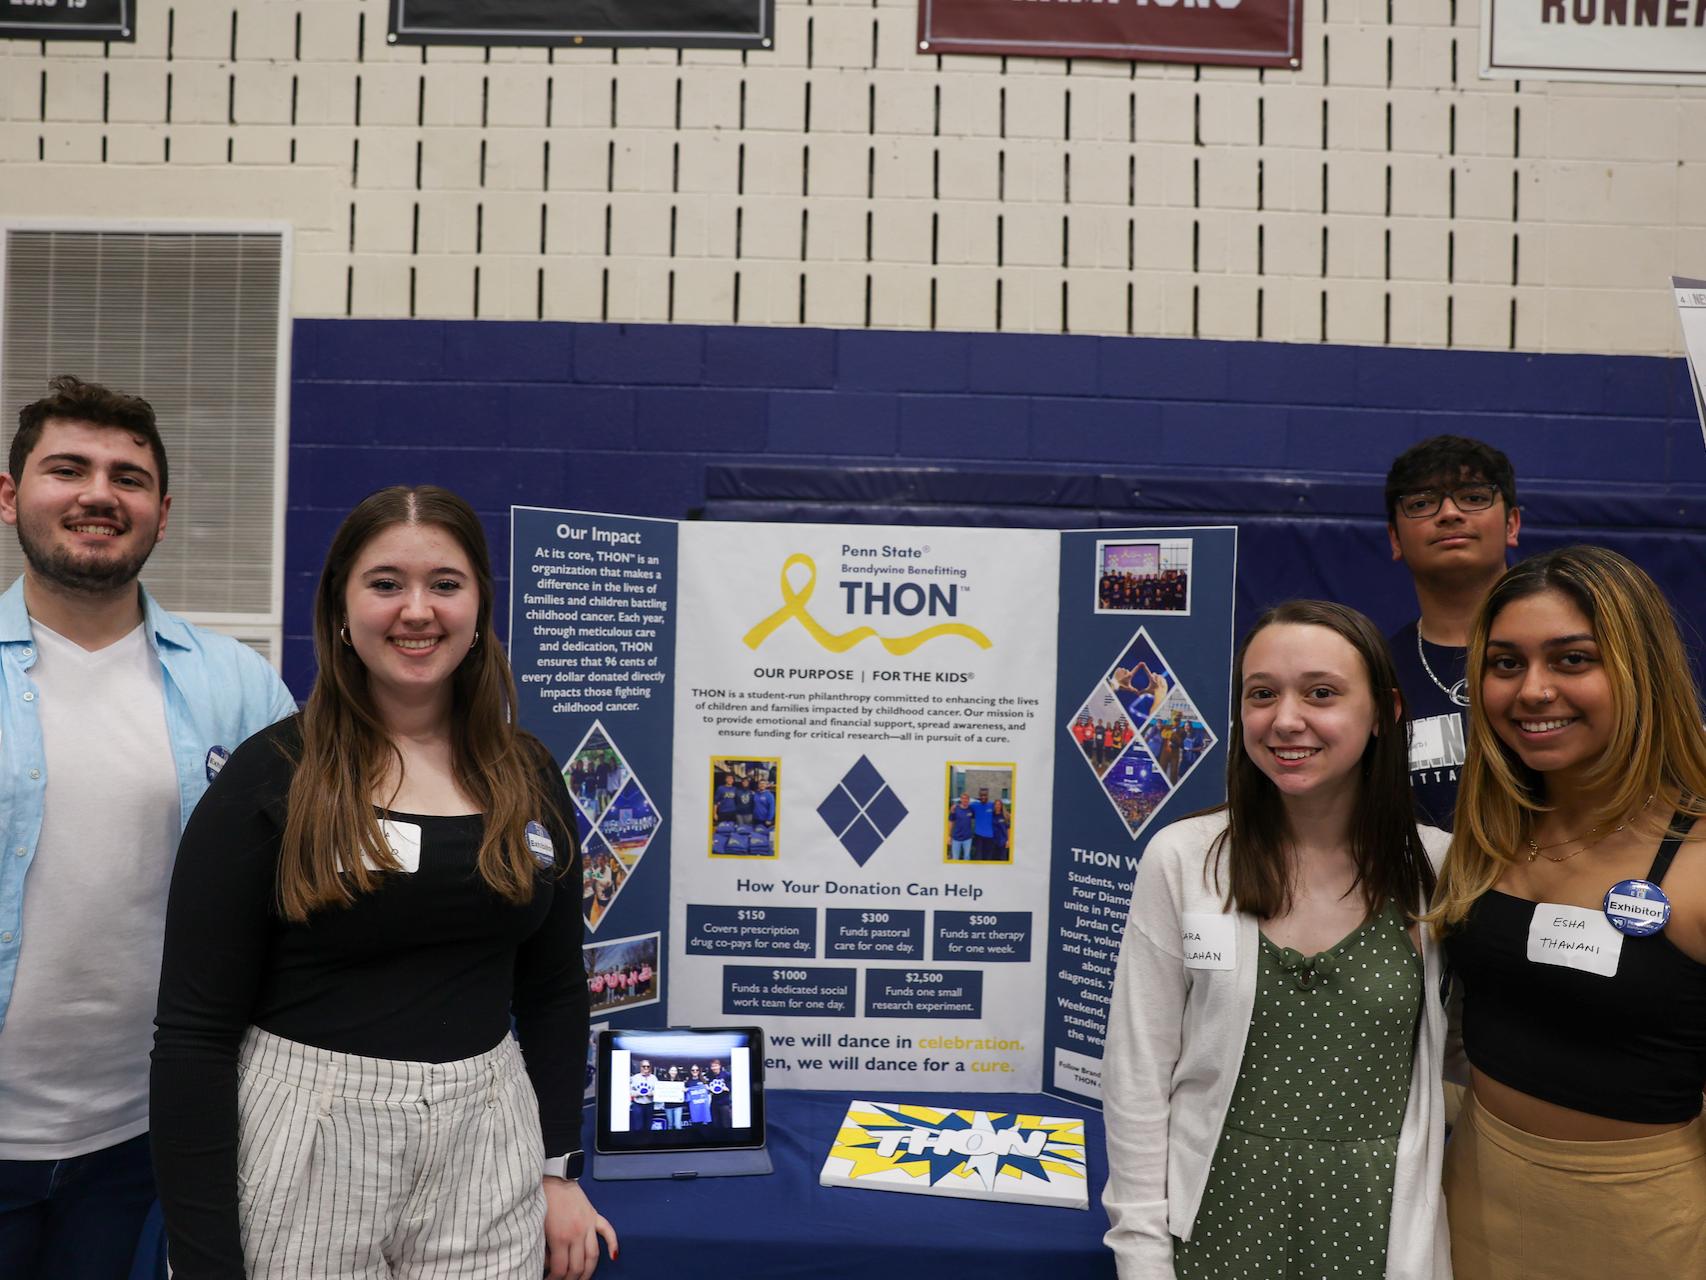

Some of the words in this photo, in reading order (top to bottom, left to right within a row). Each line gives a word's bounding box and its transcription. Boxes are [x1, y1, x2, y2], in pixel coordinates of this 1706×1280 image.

[1542, 0, 1706, 27] RUNNE
[556, 524, 587, 539] Our
[592, 526, 641, 544] Impact
[567, 551, 594, 562] core,
[842, 544, 877, 557] Penn
[531, 564, 597, 576] organization
[599, 567, 621, 577] that
[623, 569, 653, 579] makes
[841, 564, 904, 576] Brandywine
[907, 565, 966, 578] Benefitting
[536, 578, 589, 590] difference
[604, 582, 621, 592] the
[623, 582, 644, 593] lives
[523, 594, 564, 605] families
[567, 596, 586, 606] and
[588, 596, 628, 607] children
[630, 598, 667, 611] battling
[525, 610, 577, 620] childhood
[580, 613, 615, 621] cancer.
[618, 612, 640, 622] Each
[642, 614, 664, 625] year,
[533, 625, 575, 638] through
[578, 627, 632, 637] meticulous
[634, 629, 655, 637] care
[539, 641, 559, 651] and
[561, 641, 617, 652] dedication,
[620, 641, 652, 651] THON
[536, 658, 577, 666] ensures
[580, 657, 602, 666] that
[619, 658, 645, 666] cents
[521, 674, 552, 684] every
[554, 672, 585, 682] dollar
[587, 671, 628, 681] donated
[631, 671, 665, 683] directly
[753, 667, 784, 678] OUR
[789, 668, 853, 680] PURPOSE
[872, 670, 900, 681] FOR
[902, 671, 931, 682] THE
[540, 688, 581, 700] impacts
[583, 687, 612, 696] those
[614, 686, 651, 698] fighting
[691, 688, 725, 698] THON
[747, 690, 805, 699] student-run
[808, 692, 870, 703] philanthropy
[873, 694, 929, 703] committed
[945, 695, 996, 706] enhancing
[1017, 696, 1038, 705] lives
[552, 703, 603, 712] childhood
[605, 703, 639, 711] cancer.
[707, 702, 747, 711] children
[750, 703, 768, 711] and
[771, 703, 809, 712] families
[812, 704, 858, 715] impacted
[875, 706, 924, 715] childhood
[963, 708, 984, 716] Our
[986, 709, 1023, 717] mission
[716, 715, 752, 725] provide
[755, 717, 806, 725] emotional
[808, 718, 827, 726] and
[830, 717, 871, 727] financial
[873, 721, 915, 729] support,
[917, 720, 950, 730] spread
[952, 722, 1006, 731] awareness,
[1007, 722, 1026, 730] and
[753, 728, 790, 740] funding
[793, 729, 808, 738] for
[810, 730, 844, 739] critical
[926, 733, 961, 743] pursuit
[1409, 769, 1457, 786] ITTA
[1071, 847, 1120, 868] THON
[1068, 872, 1114, 890] Students,
[737, 878, 774, 892] How
[781, 880, 820, 893] Your
[825, 881, 900, 895] Donation
[906, 883, 938, 896] Can
[944, 883, 982, 900] Help
[1072, 887, 1096, 899] Four
[1098, 891, 1132, 907] Diamo
[1063, 901, 1089, 912] unite
[1610, 901, 1662, 917] Exhibitor
[737, 910, 765, 920] $150
[861, 912, 889, 923] $300
[969, 915, 996, 925] $500
[703, 922, 738, 933] Covers
[740, 925, 799, 936] prescription
[1075, 916, 1108, 931] Jordan
[1553, 917, 1586, 929] ESHA
[839, 926, 868, 936] Funds
[871, 928, 910, 939] pastoral
[940, 928, 968, 938] Funds
[988, 930, 1024, 941] therapy
[1060, 927, 1091, 943] hours,
[1183, 932, 1201, 941] ARA
[690, 937, 712, 949] drug
[715, 939, 752, 950] co-pays
[754, 938, 769, 948] for
[771, 941, 790, 949] one
[792, 939, 811, 951] day.
[834, 942, 855, 950] care
[857, 940, 872, 950] for
[874, 943, 894, 951] one
[896, 942, 914, 953] day.
[948, 942, 963, 952] for
[965, 945, 984, 953] one
[987, 944, 1015, 953] week.
[1062, 943, 1080, 954] and
[1082, 947, 1107, 959] their
[1539, 937, 1600, 954] THAWANI
[772, 970, 807, 980] $1000
[1081, 962, 1111, 975] about
[905, 972, 943, 983] $2,500
[1058, 971, 1105, 988] diagnosis.
[731, 982, 760, 993] Funds
[770, 984, 818, 994] dedicated
[820, 985, 847, 995] social
[885, 986, 914, 996] Funds
[938, 987, 962, 996] small
[733, 997, 759, 1006] work
[761, 999, 785, 1007] team
[788, 998, 803, 1008] for
[826, 999, 845, 1011] day.
[872, 1000, 913, 1010] research
[915, 1002, 974, 1012] experiment.
[1057, 997, 1106, 1019] Weekend,
[1064, 1014, 1106, 1034] standing
[770, 1036, 795, 1046] we
[801, 1033, 831, 1047] will
[837, 1033, 890, 1048] dance
[896, 1035, 911, 1048] in
[918, 1036, 1024, 1050] celebration.
[1067, 1029, 1084, 1040] the
[764, 1058, 791, 1071] en,
[797, 1059, 822, 1069] we
[828, 1056, 858, 1070] will
[864, 1056, 917, 1071] dance
[923, 1057, 949, 1071] for
[971, 1061, 1014, 1072] cure.
[866, 1128, 1048, 1158] THON
